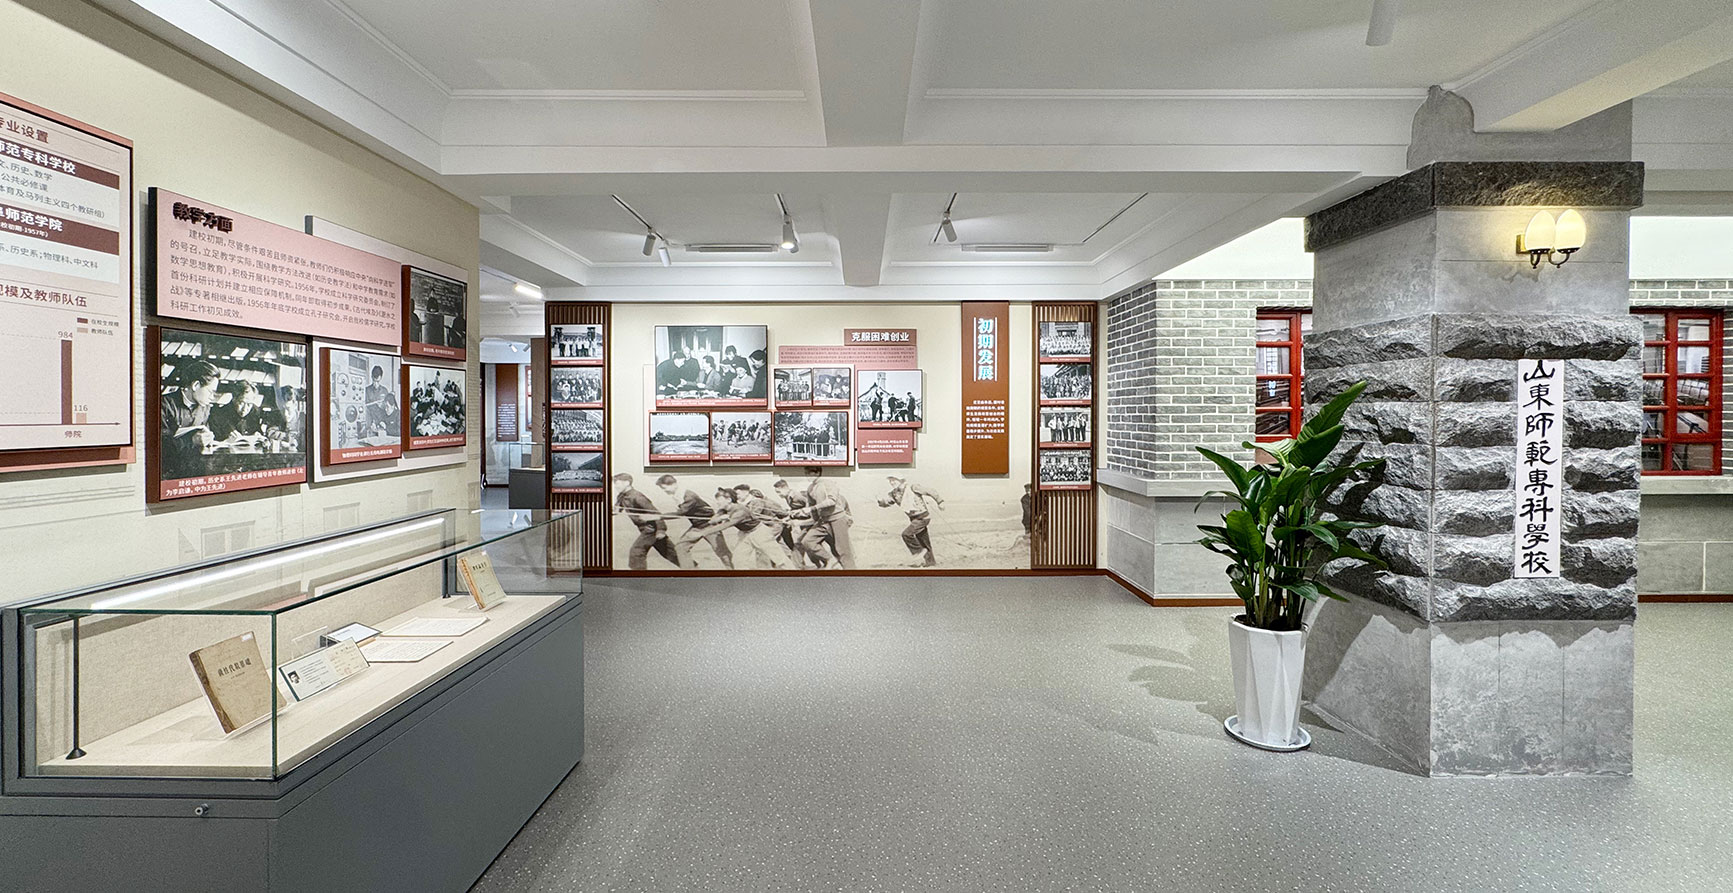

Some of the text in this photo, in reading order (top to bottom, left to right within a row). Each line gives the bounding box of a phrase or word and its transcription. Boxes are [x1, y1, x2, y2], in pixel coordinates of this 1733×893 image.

[0, 284, 88, 308] 模及教师队伍
[58, 331, 73, 339] 984
[851, 331, 910, 342] 克服困难创业
[978, 318, 994, 380] 初期发展
[74, 404, 88, 412] 116
[64, 430, 82, 438] 师院
